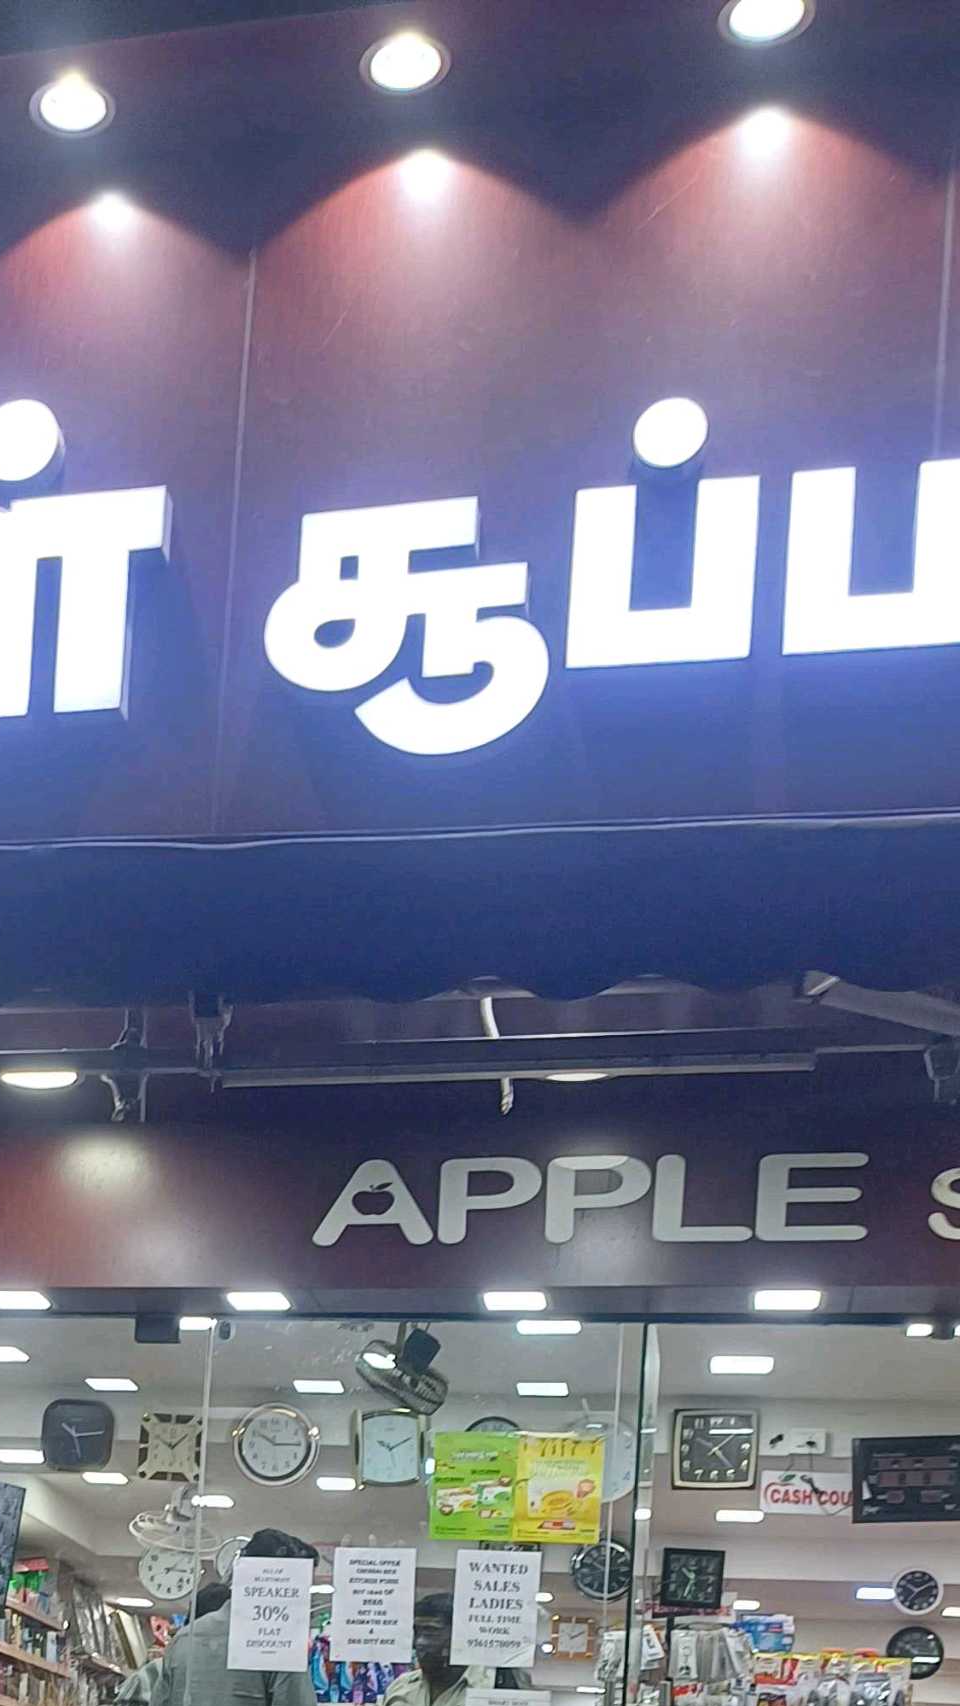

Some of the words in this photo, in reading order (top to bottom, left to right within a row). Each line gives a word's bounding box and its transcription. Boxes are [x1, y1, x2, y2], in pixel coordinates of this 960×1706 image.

[311, 1152, 870, 1247] APPLE
[770, 1488, 813, 1505] CASH
[469, 1561, 529, 1575] WANTED
[243, 1586, 300, 1598] SPEAKER
[473, 1580, 521, 1593] SALES
[469, 1597, 524, 1610] LADIES
[252, 1604, 290, 1622] 30%
[468, 1614, 494, 1623] FULL
[497, 1615, 522, 1624] TIME
[258, 1627, 282, 1637] FLAT
[478, 1626, 511, 1635] WORK
[245, 1639, 293, 1649] DISCOUNT
